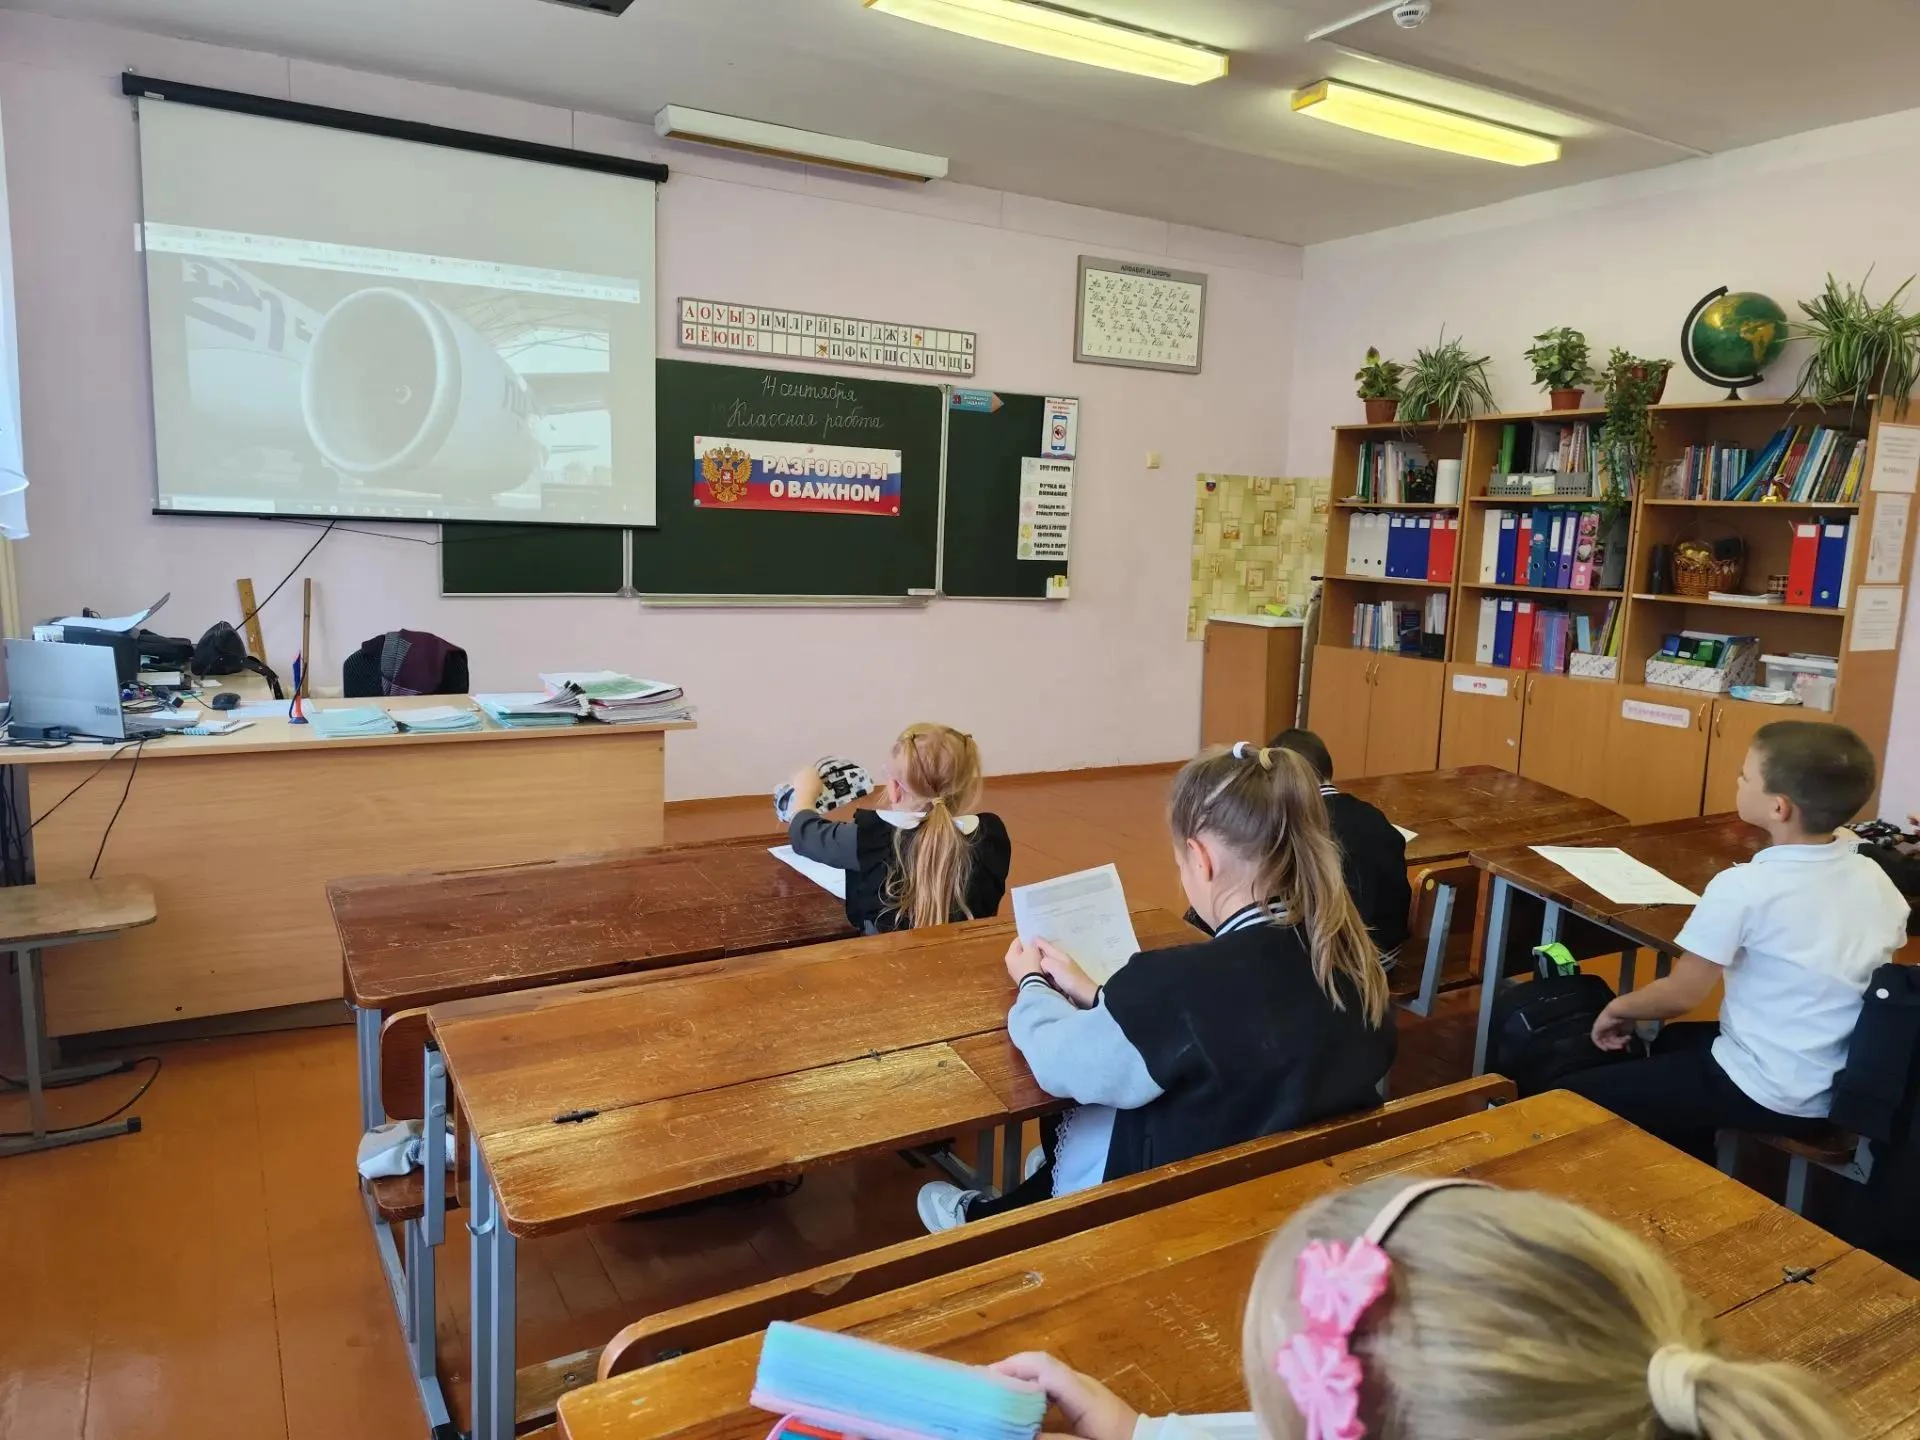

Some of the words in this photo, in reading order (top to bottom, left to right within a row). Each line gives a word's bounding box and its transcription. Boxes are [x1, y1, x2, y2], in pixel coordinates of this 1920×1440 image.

[685, 306, 694, 318] А
[700, 306, 710, 319] О
[716, 308, 726, 320] У
[730, 310, 742, 324] Ы
[747, 312, 756, 324] Э
[761, 314, 770, 326] Н
[774, 316, 786, 328] М
[790, 318, 799, 330] Л
[806, 319, 813, 331] Р
[818, 318, 828, 332] Й
[833, 322, 841, 334] Б
[847, 324, 855, 336] В
[861, 326, 868, 338] Г
[873, 328, 882, 340] Д
[886, 328, 898, 342] Ж
[902, 330, 908, 343] З
[964, 338, 972, 350] Ъ
[684, 328, 694, 340] Я
[701, 326, 710, 342] Ё
[714, 332, 728, 344] Ю
[730, 332, 740, 346] И
[747, 334, 755, 347] Е
[832, 344, 841, 356] П
[844, 346, 856, 358] Ф
[860, 347, 868, 359] К
[874, 348, 882, 360] Т
[900, 351, 908, 363] С
[912, 352, 921, 365] Х
[926, 354, 934, 367] Ц
[938, 356, 946, 368] Ч
[964, 359, 972, 370] Ь
[761, 375, 776, 396] 14
[780, 381, 857, 408] сентября
[727, 398, 818, 428] Классная
[823, 405, 883, 439] работа
[762, 455, 888, 480] РАЗГОВОРЫ
[769, 479, 785, 498] О
[788, 480, 880, 502] ВАЖНОМ
